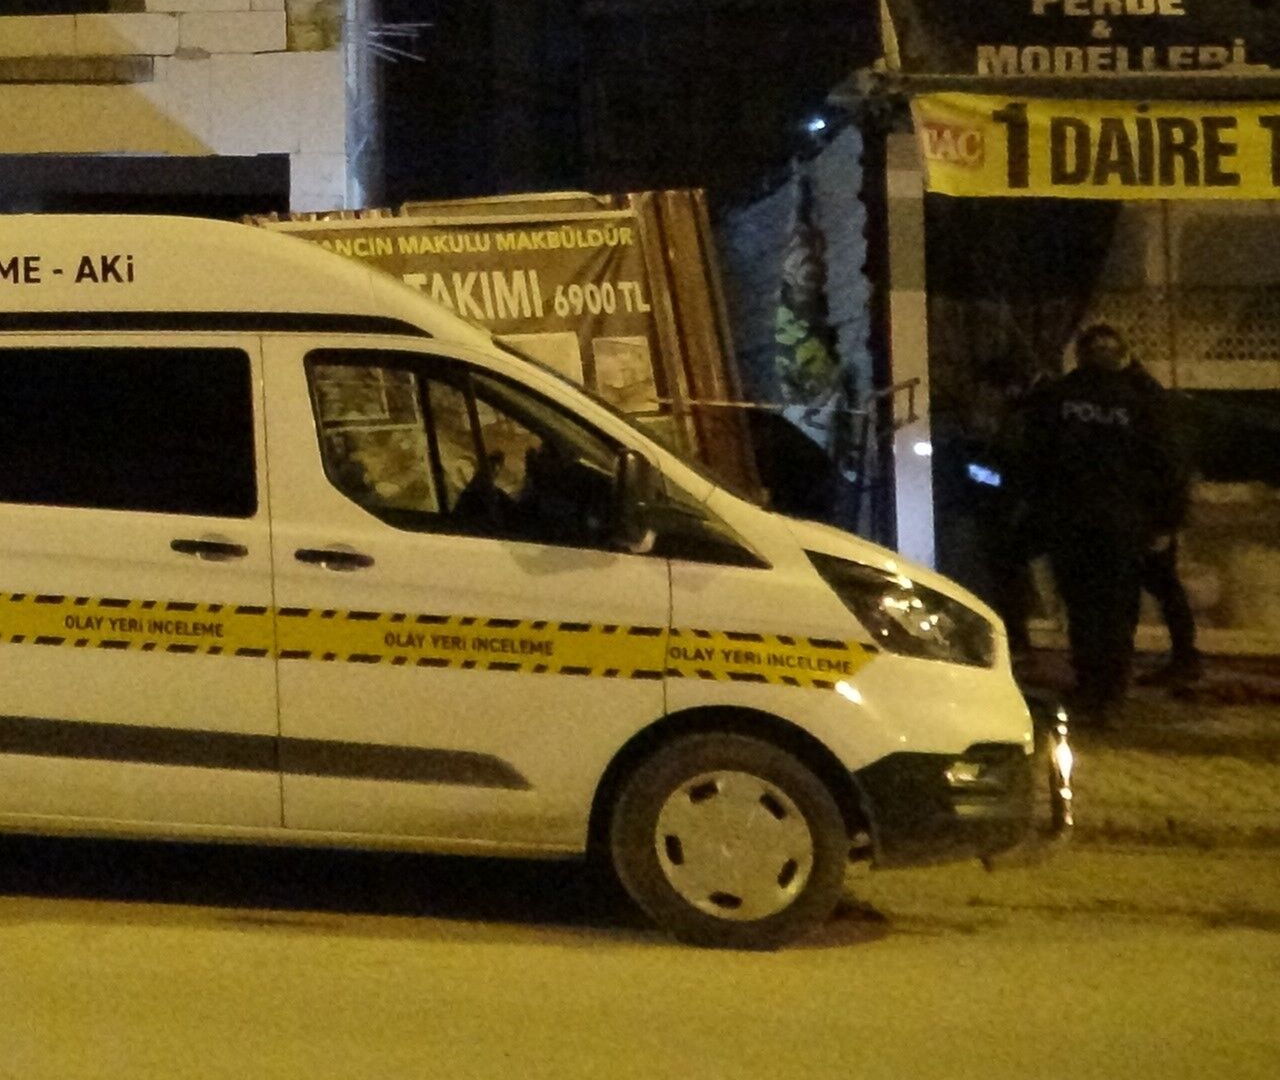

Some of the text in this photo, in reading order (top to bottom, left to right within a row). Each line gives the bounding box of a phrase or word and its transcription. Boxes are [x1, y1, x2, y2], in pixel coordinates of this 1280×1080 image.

[1090, 19, 1113, 39] &
[991, 102, 1029, 189] 1
[397, 232, 490, 255] MAKULU
[553, 282, 615, 318] 6900
[618, 281, 652, 313] TL
[64, 614, 104, 631] OLAY
[384, 631, 426, 649] OLAY
[669, 646, 715, 662] OLAY
